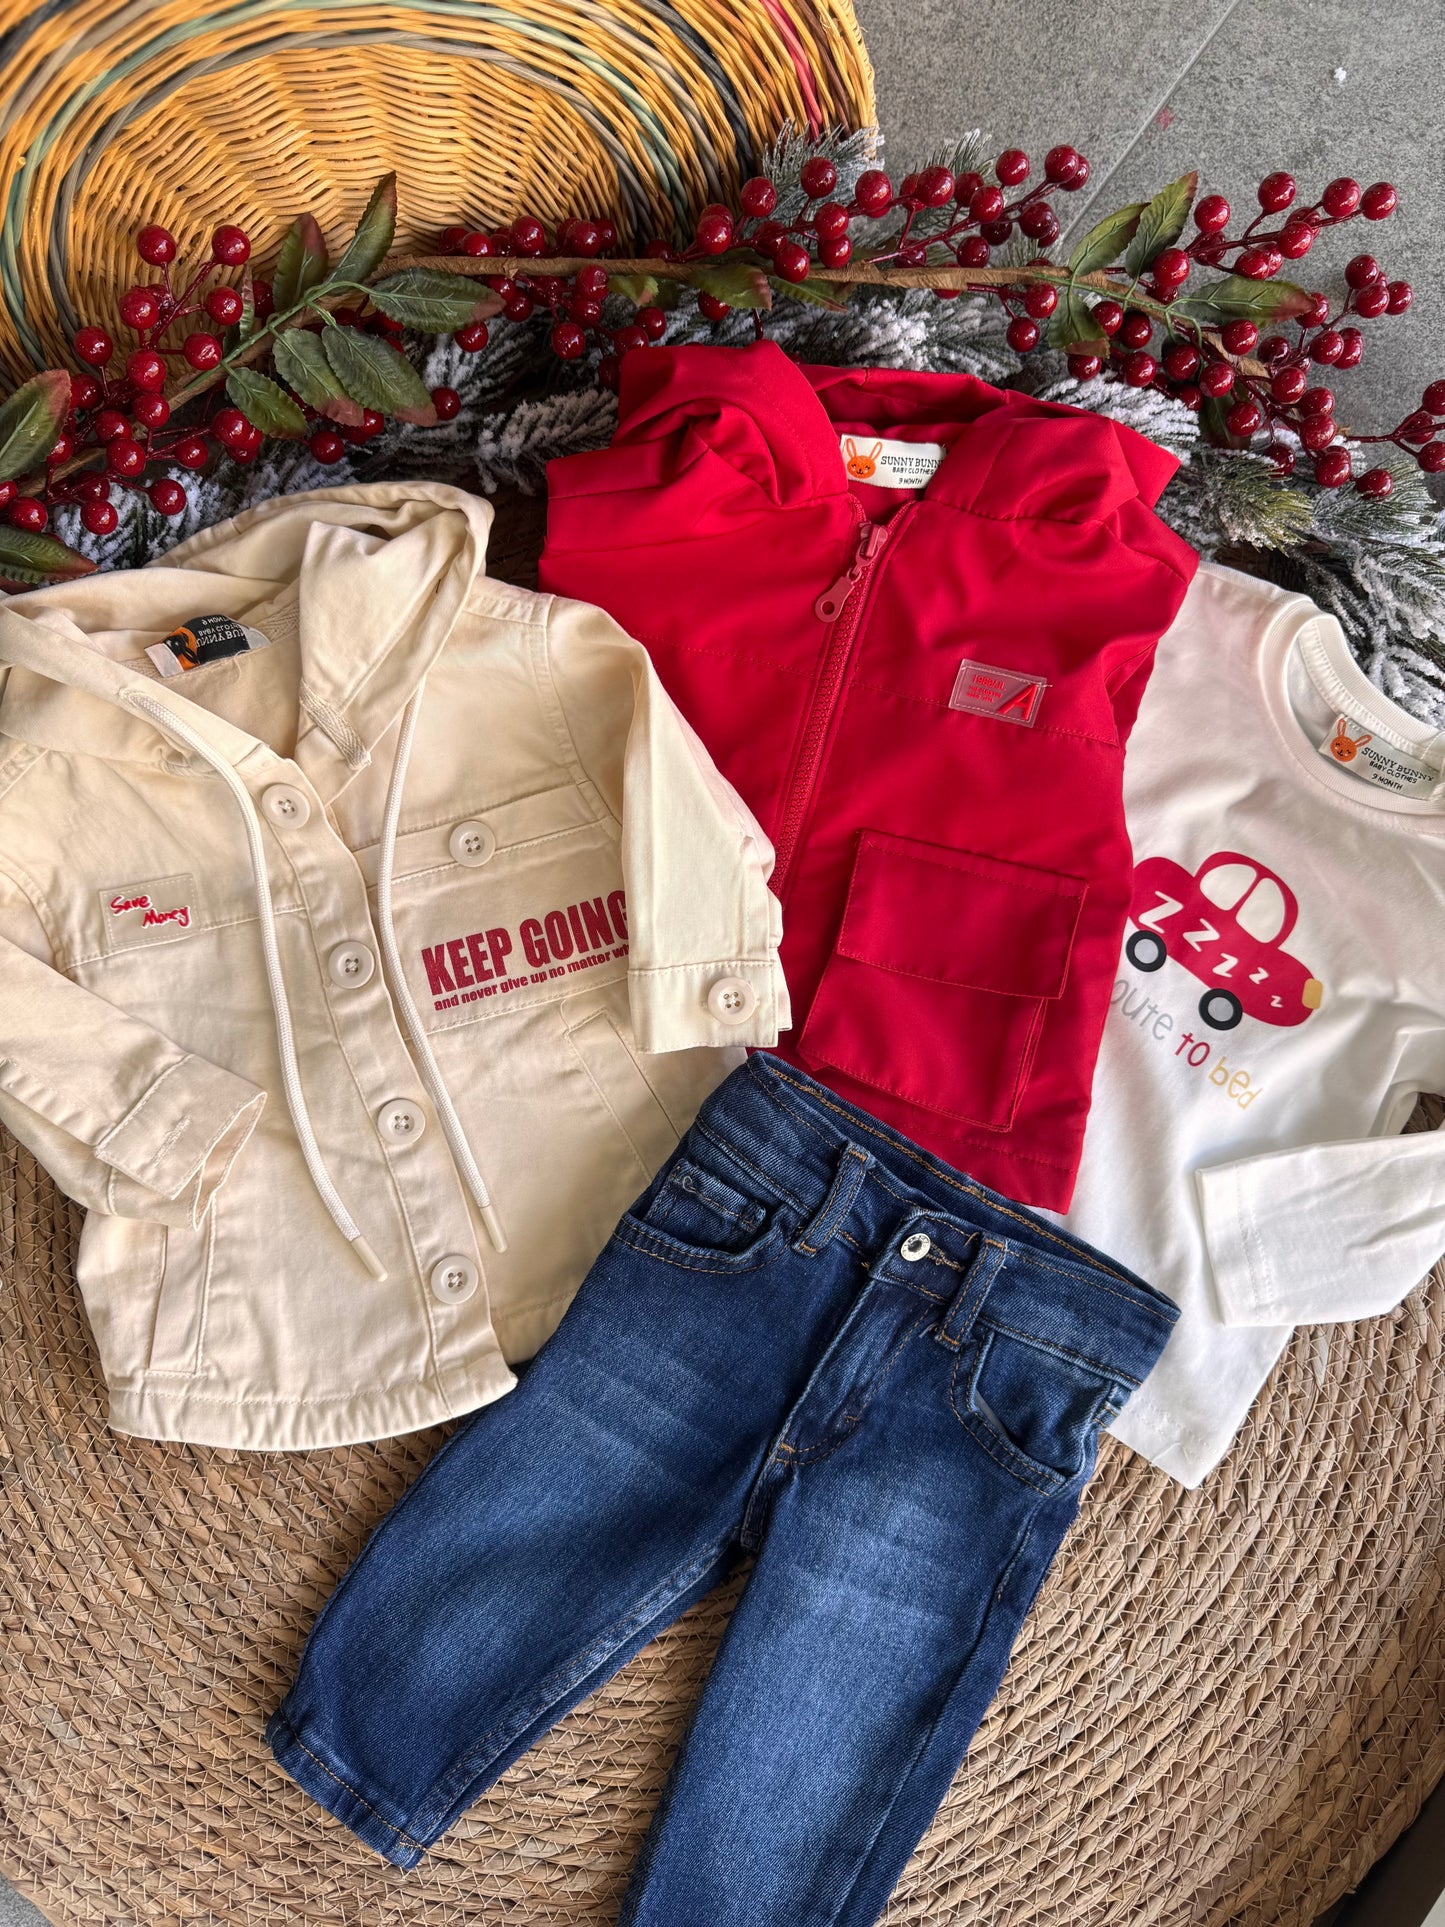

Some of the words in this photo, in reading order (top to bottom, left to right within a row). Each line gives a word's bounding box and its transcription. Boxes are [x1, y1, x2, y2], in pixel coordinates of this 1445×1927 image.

[881, 455, 914, 467] SUNNY
[915, 458, 943, 469] BUNN
[908, 467, 934, 475] CLOTHES
[1361, 746, 1398, 769] SUNNY
[1396, 764, 1434, 782] BUNNY
[1368, 760, 1388, 775] BABY
[1386, 768, 1417, 784] CLOTHES
[1378, 775, 1403, 790] MONTH
[110, 895, 152, 916] Save
[421, 927, 513, 996] KEEP
[519, 890, 629, 968] GOING
[434, 994, 459, 1011] and
[461, 984, 498, 1004] never
[500, 975, 528, 994] give
[530, 971, 548, 986] up
[549, 965, 566, 979] no
[567, 952, 611, 974] matter
[1175, 1032, 1210, 1067] to
[1208, 1056, 1263, 1110] bed
